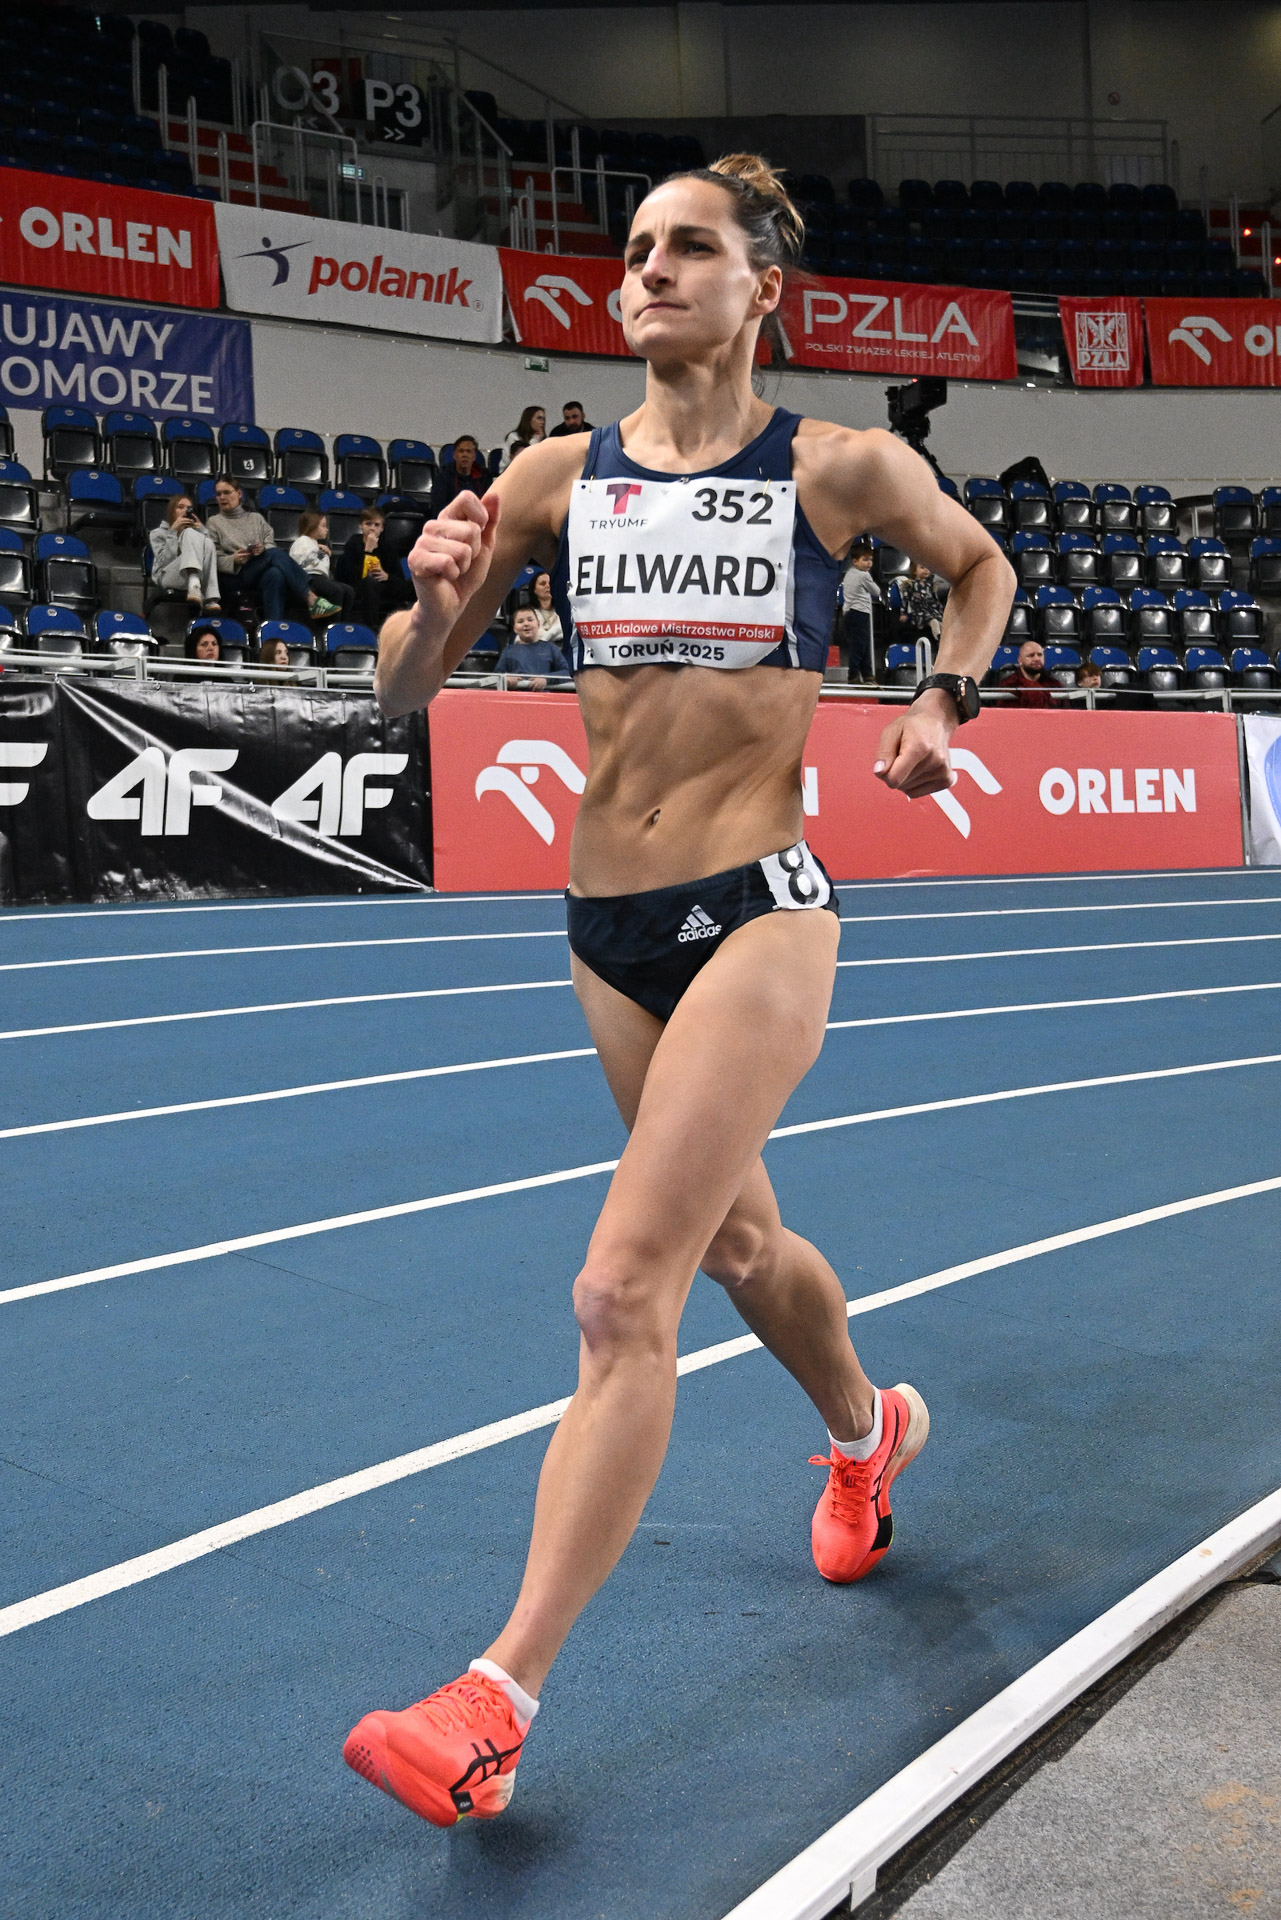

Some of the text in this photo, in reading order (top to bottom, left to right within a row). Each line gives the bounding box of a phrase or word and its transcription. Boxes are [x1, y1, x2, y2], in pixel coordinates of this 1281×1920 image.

[364, 78, 422, 128] P3
[19, 206, 192, 269] ORLEN
[307, 254, 473, 308] polanik
[0, 303, 174, 361] UJAWY
[803, 290, 979, 347] PZLA
[805, 342, 844, 353] POLSKI
[1079, 351, 1127, 367] PZLA
[1, 355, 215, 414] OMORZE
[589, 518, 648, 530] TRYUMF
[691, 488, 774, 525] 352
[575, 554, 776, 597] ELLWARD
[591, 623, 612, 635] PZLA
[614, 622, 658, 634] Halowe
[661, 623, 736, 637] Mistrzostwa
[738, 626, 775, 639] Polski
[608, 639, 725, 661] TORUŃ 2025
[86, 746, 239, 836] 4F
[271, 751, 409, 836] 4F
[1039, 767, 1197, 815] ORLEN
[778, 845, 819, 905] 8
[677, 923, 722, 943] adidas
